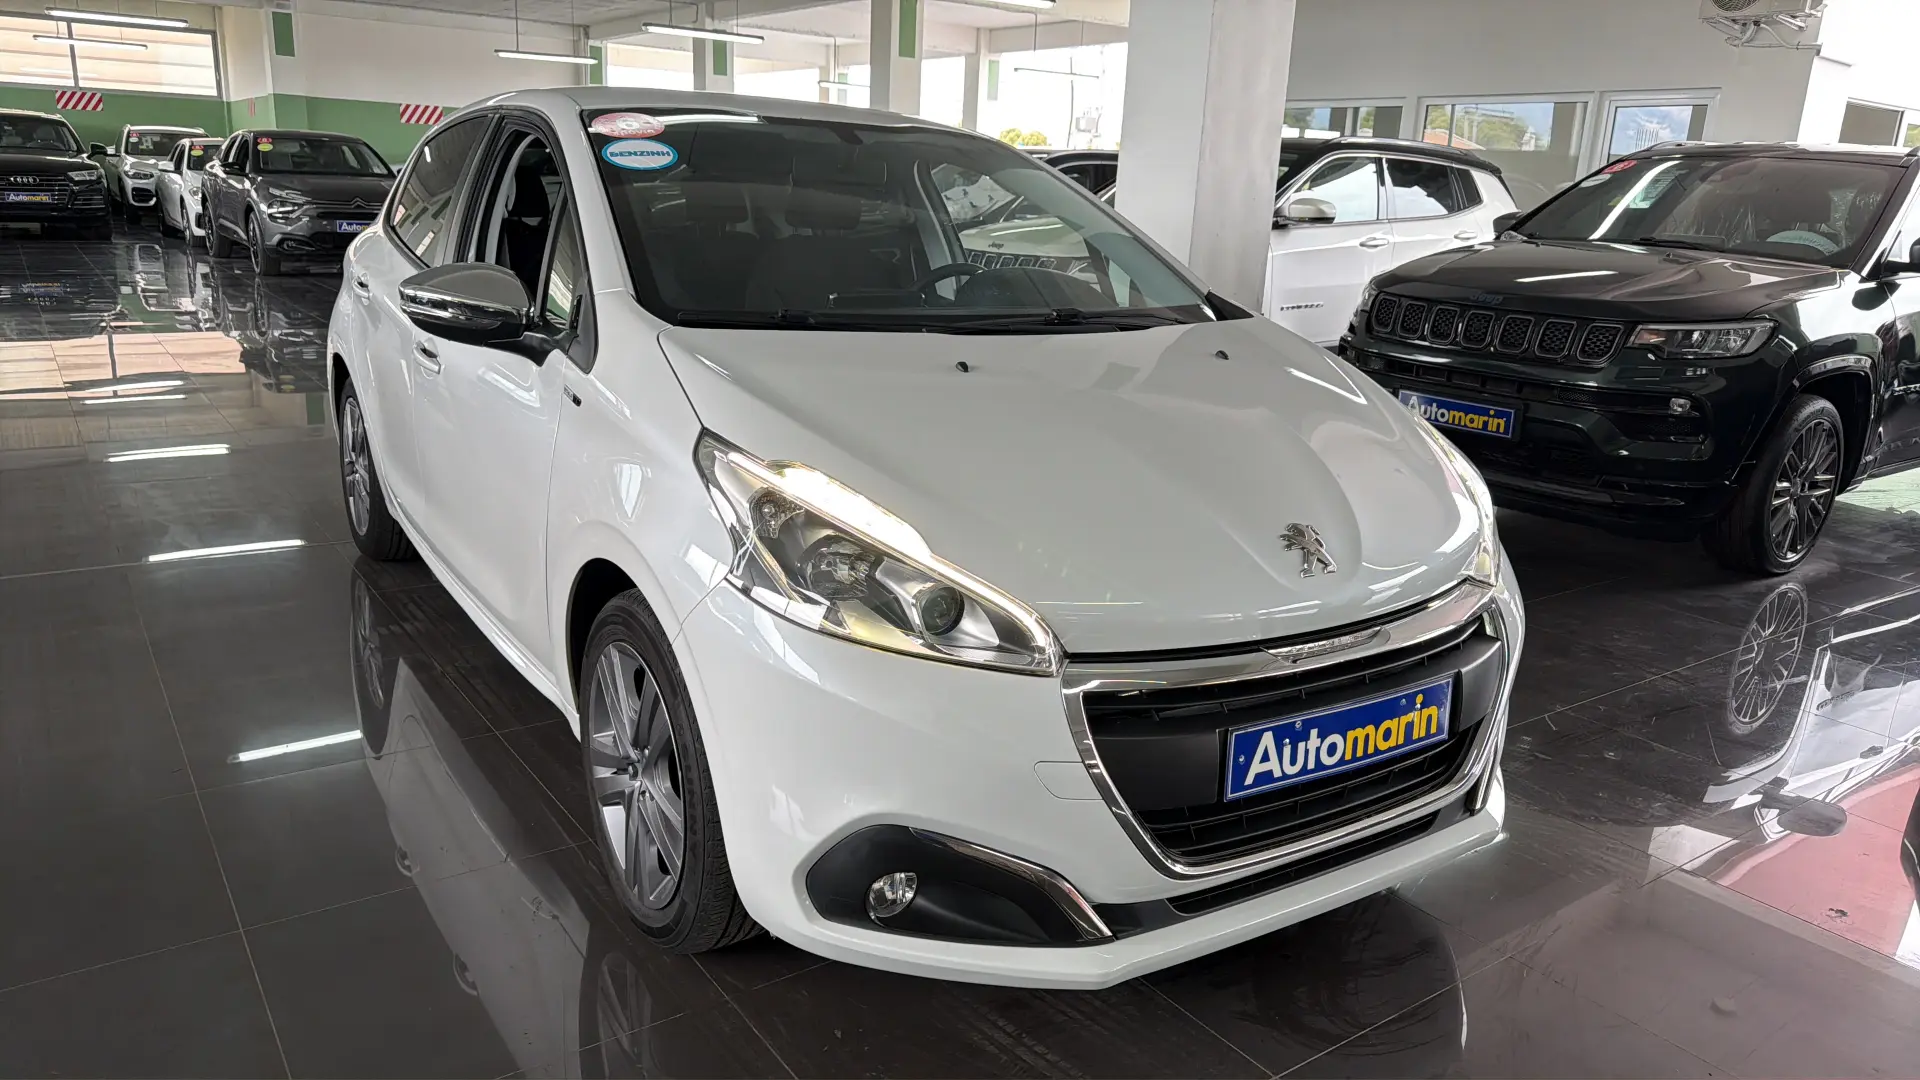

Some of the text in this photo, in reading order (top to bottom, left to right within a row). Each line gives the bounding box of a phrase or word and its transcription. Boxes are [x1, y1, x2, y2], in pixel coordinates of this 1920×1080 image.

[8, 193, 49, 202] Automarin
[1407, 396, 1506, 433] Automarin
[1244, 693, 1439, 786] Automarin
